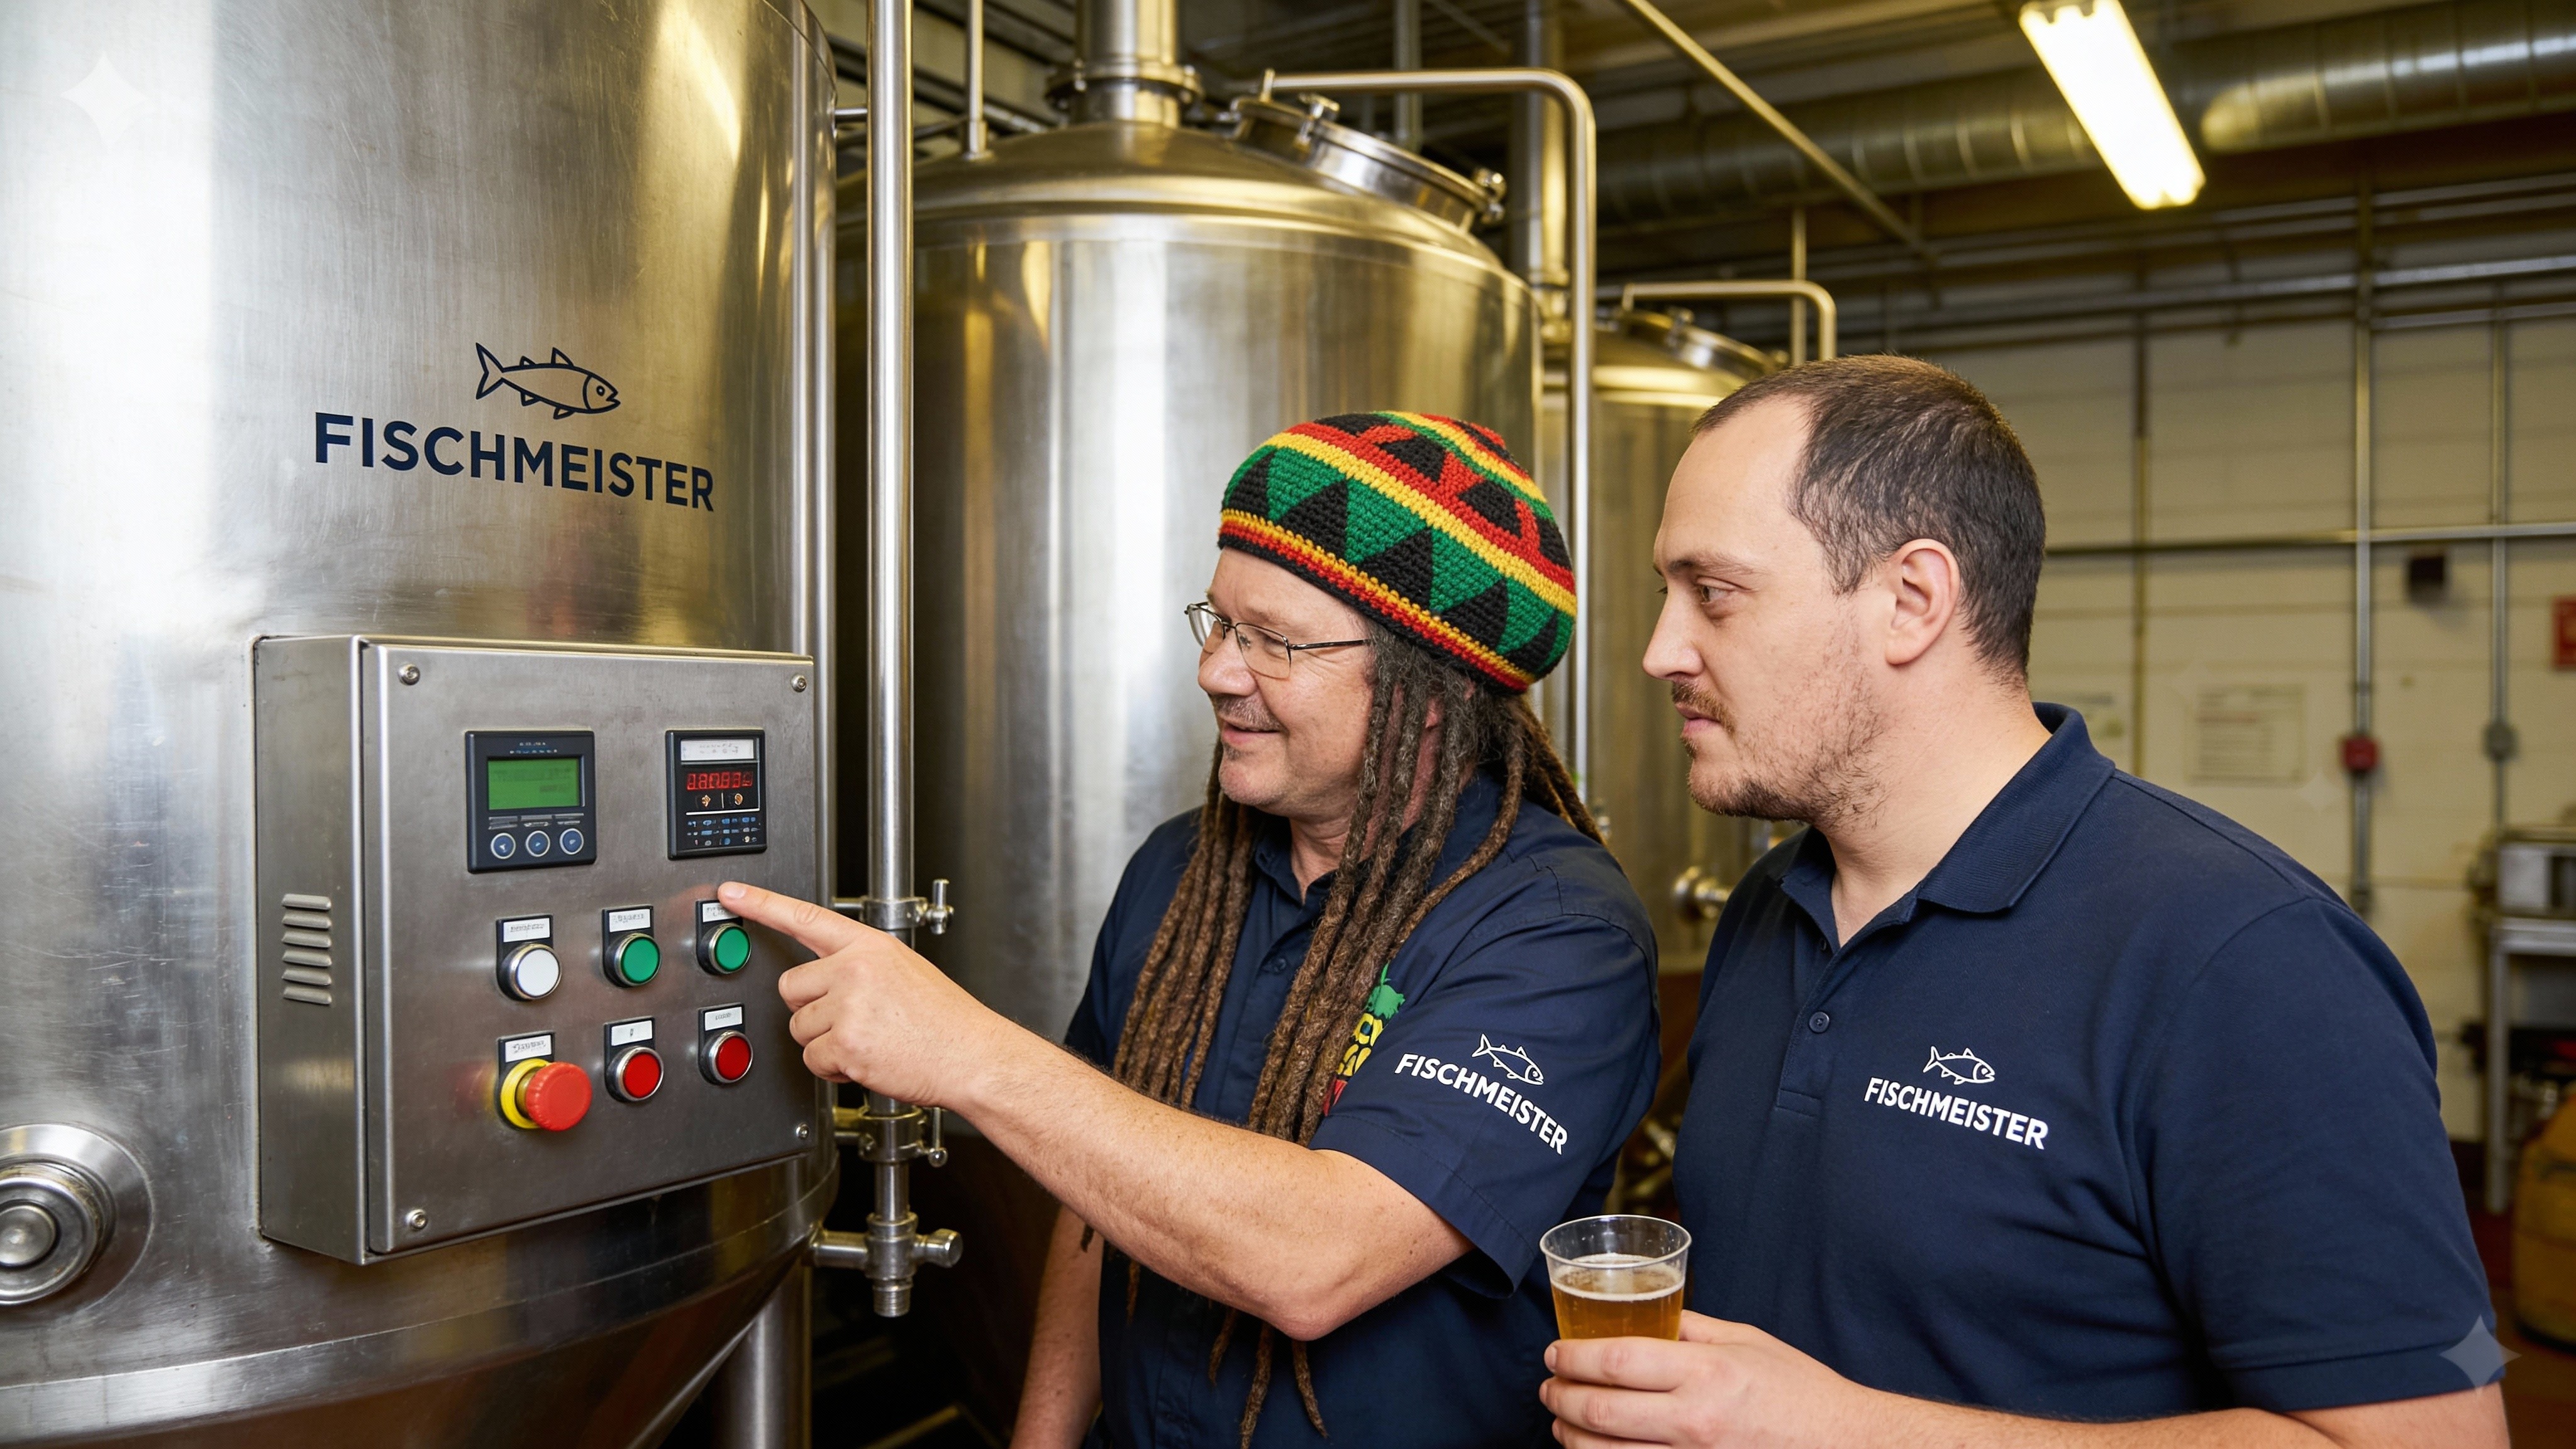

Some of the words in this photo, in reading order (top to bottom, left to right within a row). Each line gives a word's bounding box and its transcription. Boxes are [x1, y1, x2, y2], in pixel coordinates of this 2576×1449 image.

[314, 412, 715, 513] FISCHMEISTER
[1394, 1053, 1568, 1155] FISCHMEISTER
[1863, 1077, 2049, 1150] FISCHMEISTER
